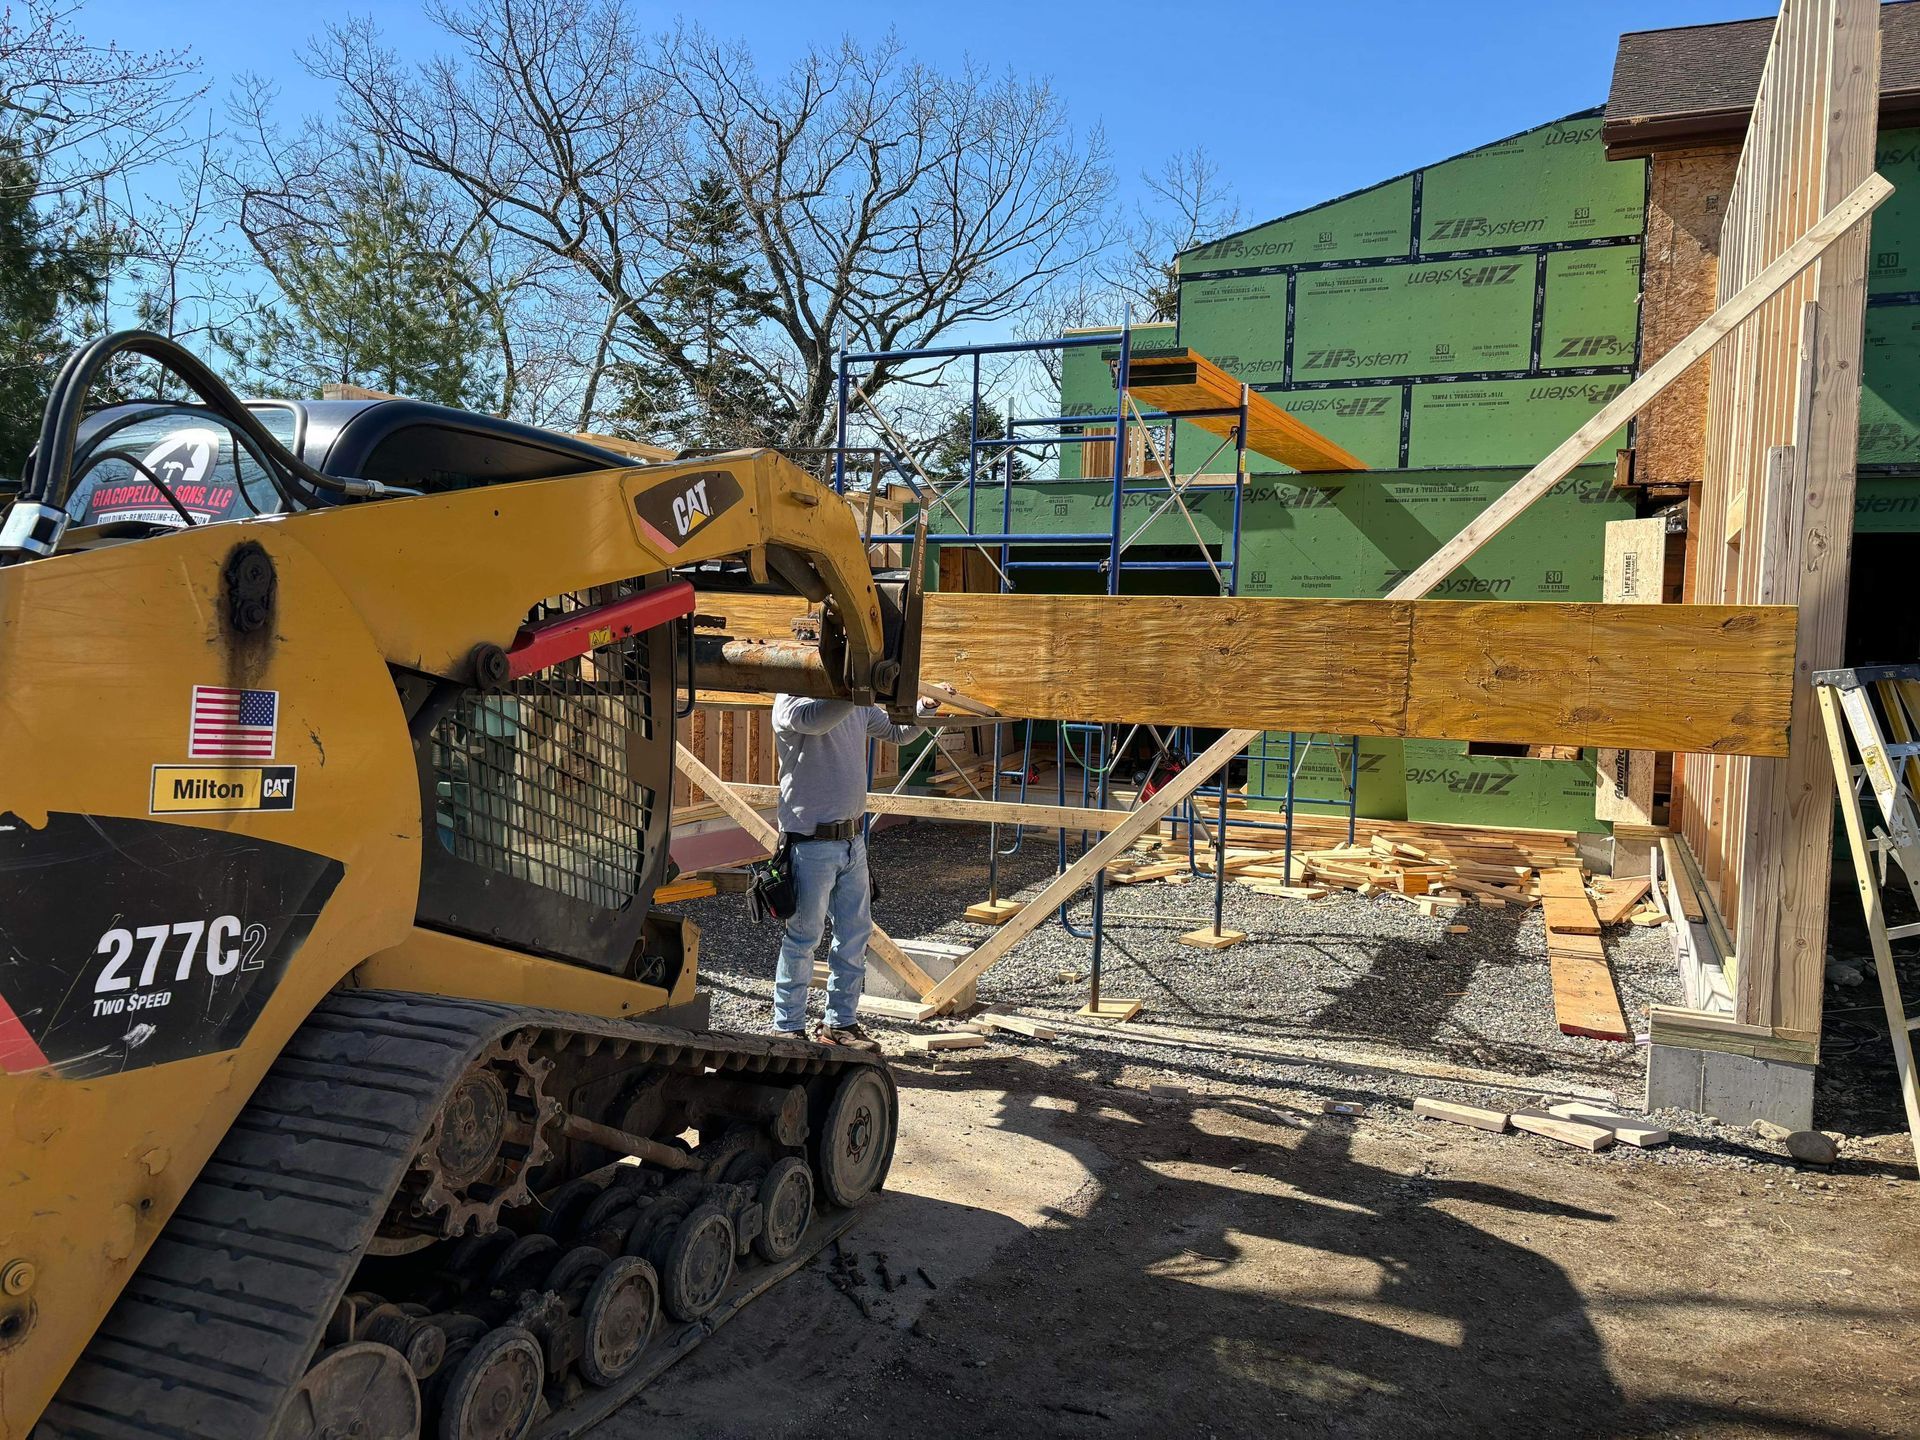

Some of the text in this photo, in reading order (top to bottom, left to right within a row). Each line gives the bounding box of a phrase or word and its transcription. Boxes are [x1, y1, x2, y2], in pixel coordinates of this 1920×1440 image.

[1575, 207, 1589, 219] 30
[1319, 232, 1332, 244] 30
[1878, 253, 1899, 268] 30
[1436, 343, 1450, 355] 30
[207, 487, 233, 509] LLC
[672, 478, 711, 536] CAT
[1545, 571, 1563, 584] 30
[1624, 554, 1632, 594] LIFETIME
[1614, 749, 1625, 801] AdvanTec
[173, 779, 244, 800] Milton
[263, 778, 291, 798] CAT
